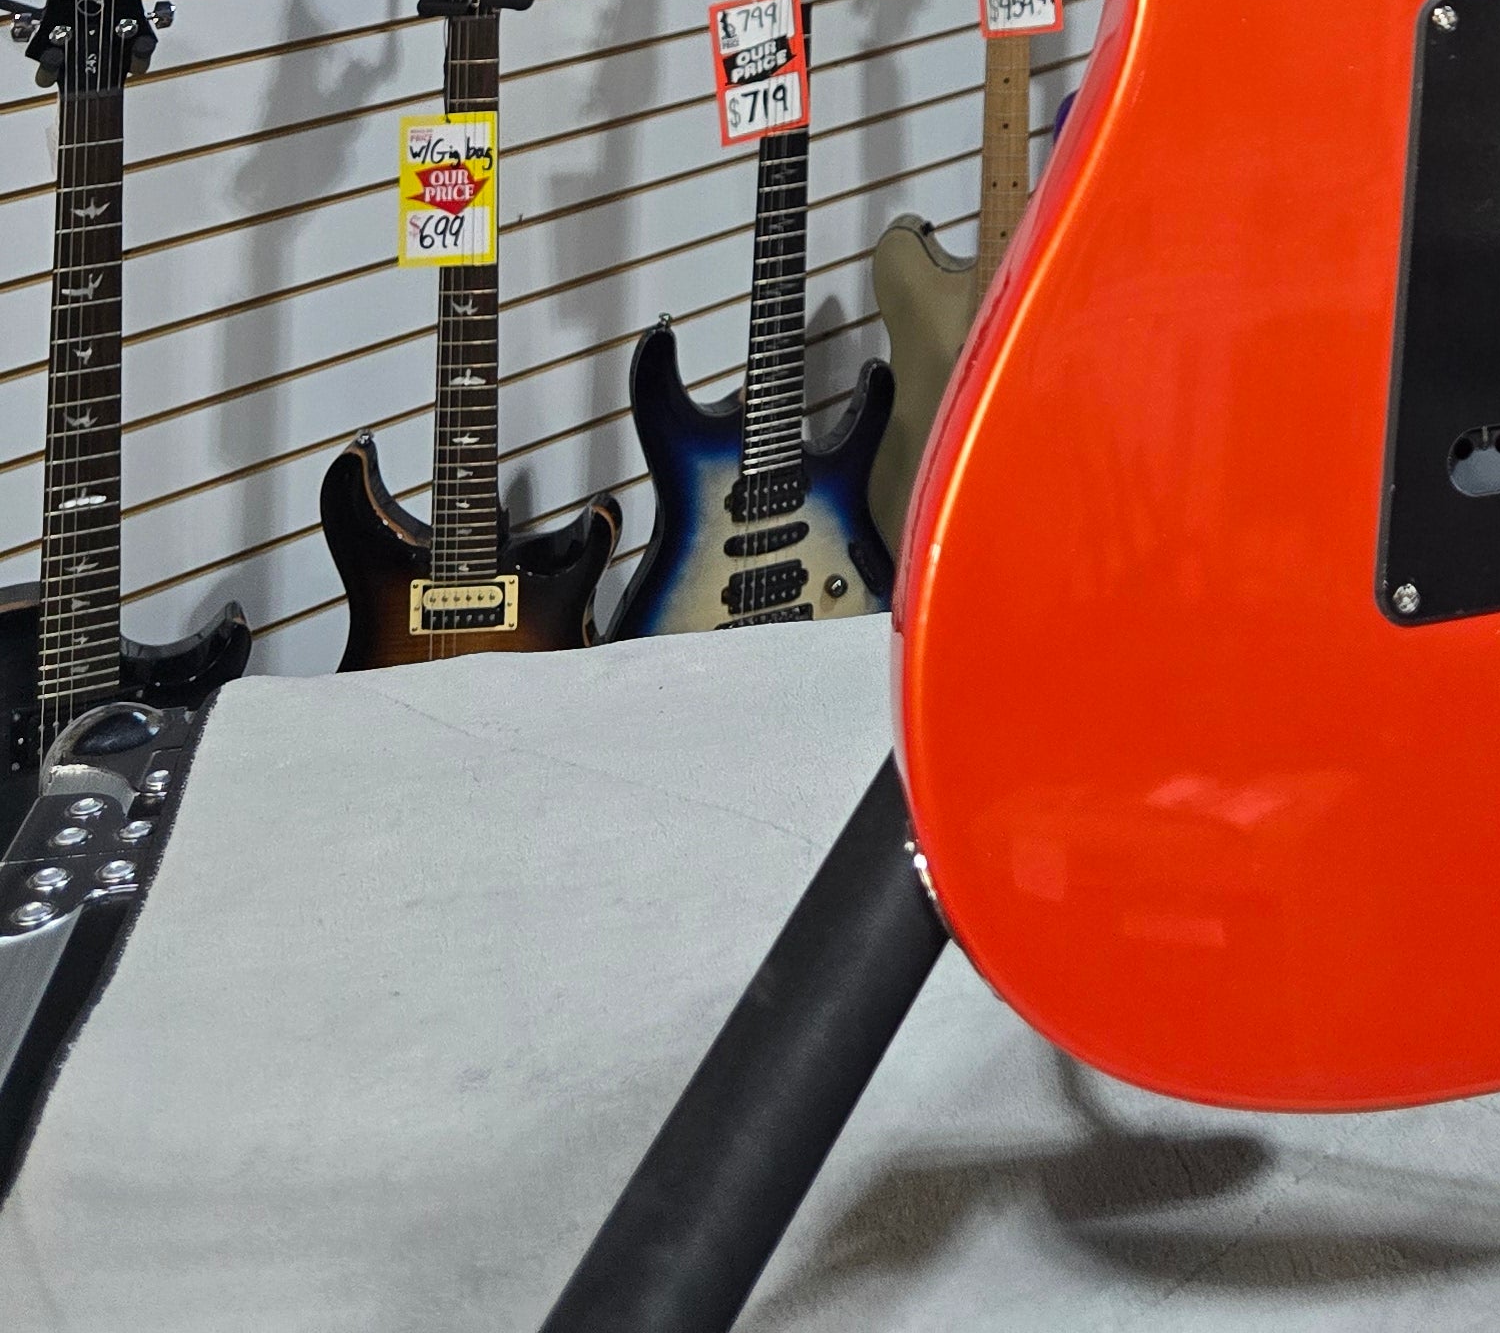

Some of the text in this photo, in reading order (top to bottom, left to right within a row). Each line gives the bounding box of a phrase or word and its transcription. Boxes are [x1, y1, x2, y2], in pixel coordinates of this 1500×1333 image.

[731, 49, 788, 83] PRICE
[736, 40, 777, 66] OUR
[729, 84, 788, 128] $719
[430, 169, 469, 186] OUR
[424, 183, 475, 203] PRICE
[409, 214, 464, 249] $699
